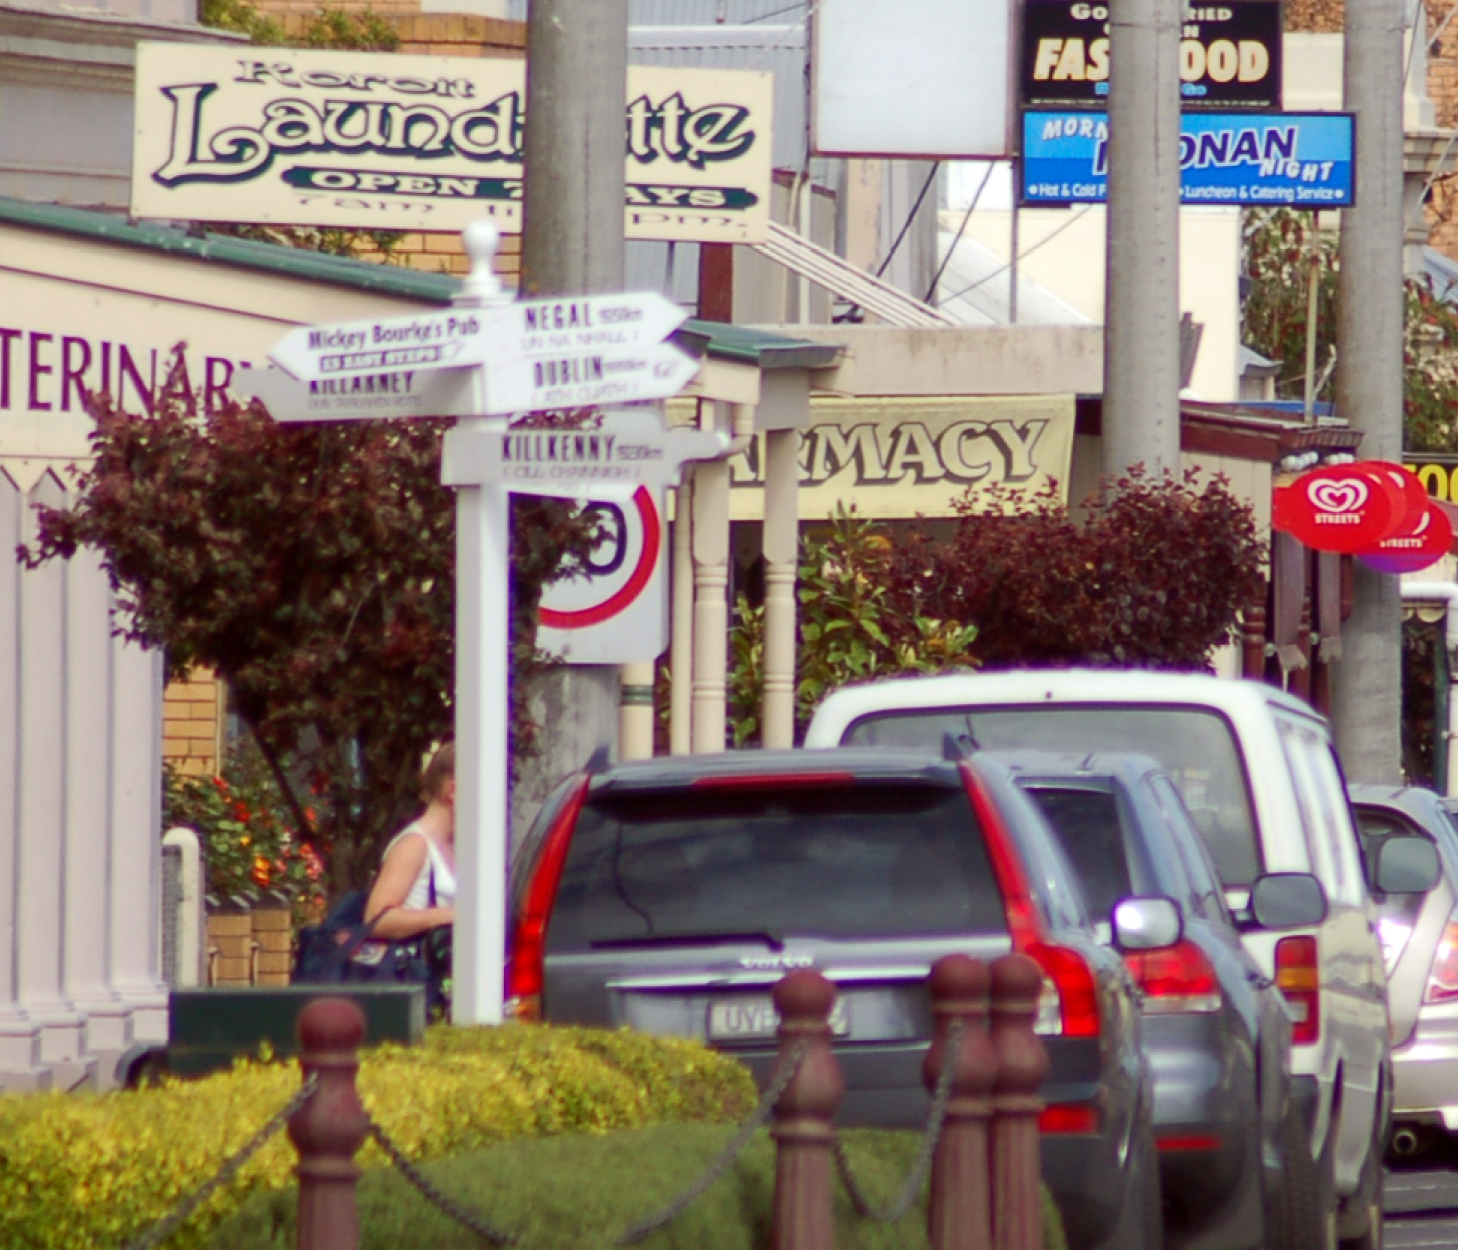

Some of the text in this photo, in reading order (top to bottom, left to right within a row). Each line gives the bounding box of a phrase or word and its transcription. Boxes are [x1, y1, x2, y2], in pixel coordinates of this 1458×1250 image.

[1185, 7, 1233, 21] RIED
[1033, 37, 1269, 82] FAS OOD
[233, 60, 477, 98] Koroit
[151, 82, 756, 188] Laundtte
[1042, 117, 1108, 141] MORN
[1259, 157, 1334, 182] NIGHT
[311, 170, 479, 197] OPEN
[626, 185, 726, 207] AYS
[1039, 184, 1060, 197] Hot
[1072, 184, 1096, 197] Cold
[1185, 186, 1333, 202] Luncheon & Catering Service
[525, 301, 593, 332] NEGAL
[308, 315, 481, 351] Mickey Bourke's Pub
[534, 355, 603, 388] DUBLIN
[501, 434, 617, 462] KILLKENNY
[1315, 512, 1361, 525] STREETS
